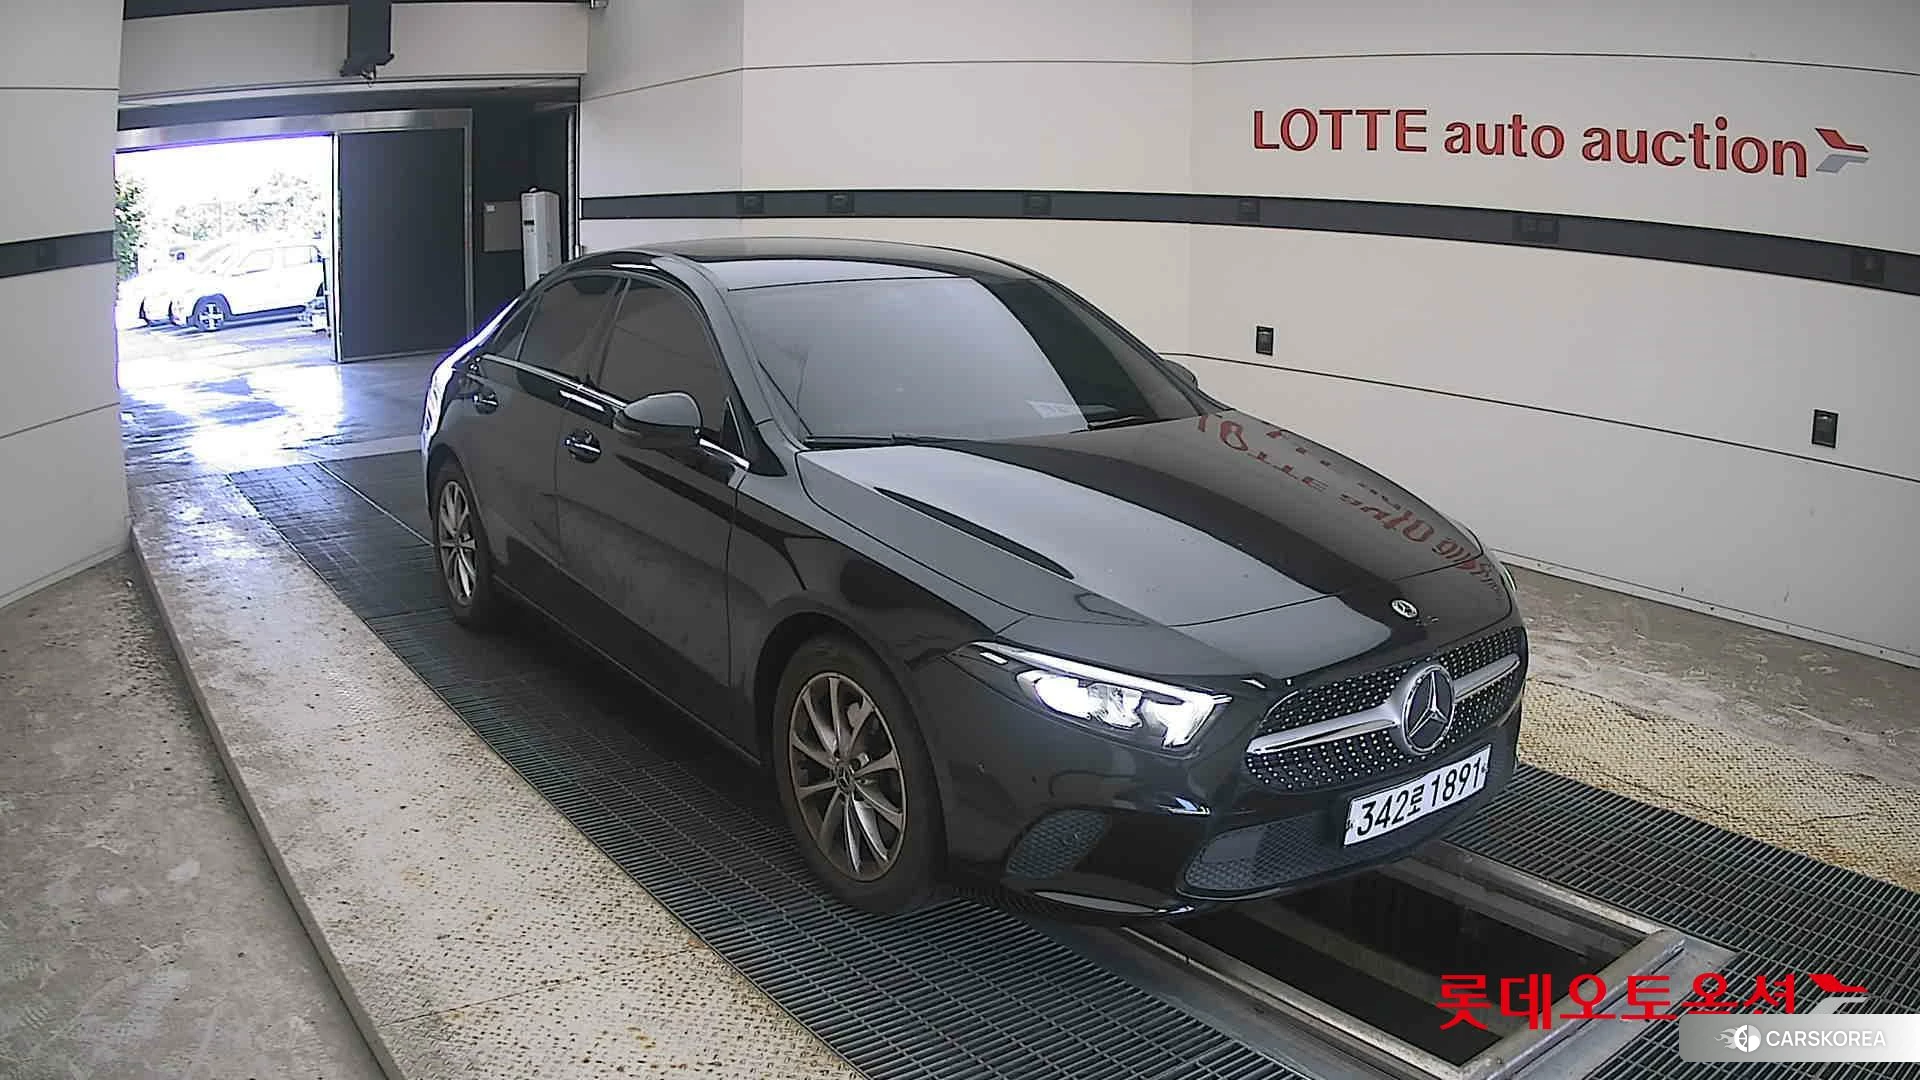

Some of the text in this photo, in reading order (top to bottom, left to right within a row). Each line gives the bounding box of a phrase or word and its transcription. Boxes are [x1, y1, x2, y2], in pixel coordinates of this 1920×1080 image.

[1254, 108, 1808, 178] LOTTE auto auction
[1356, 756, 1482, 836] 342로 1891
